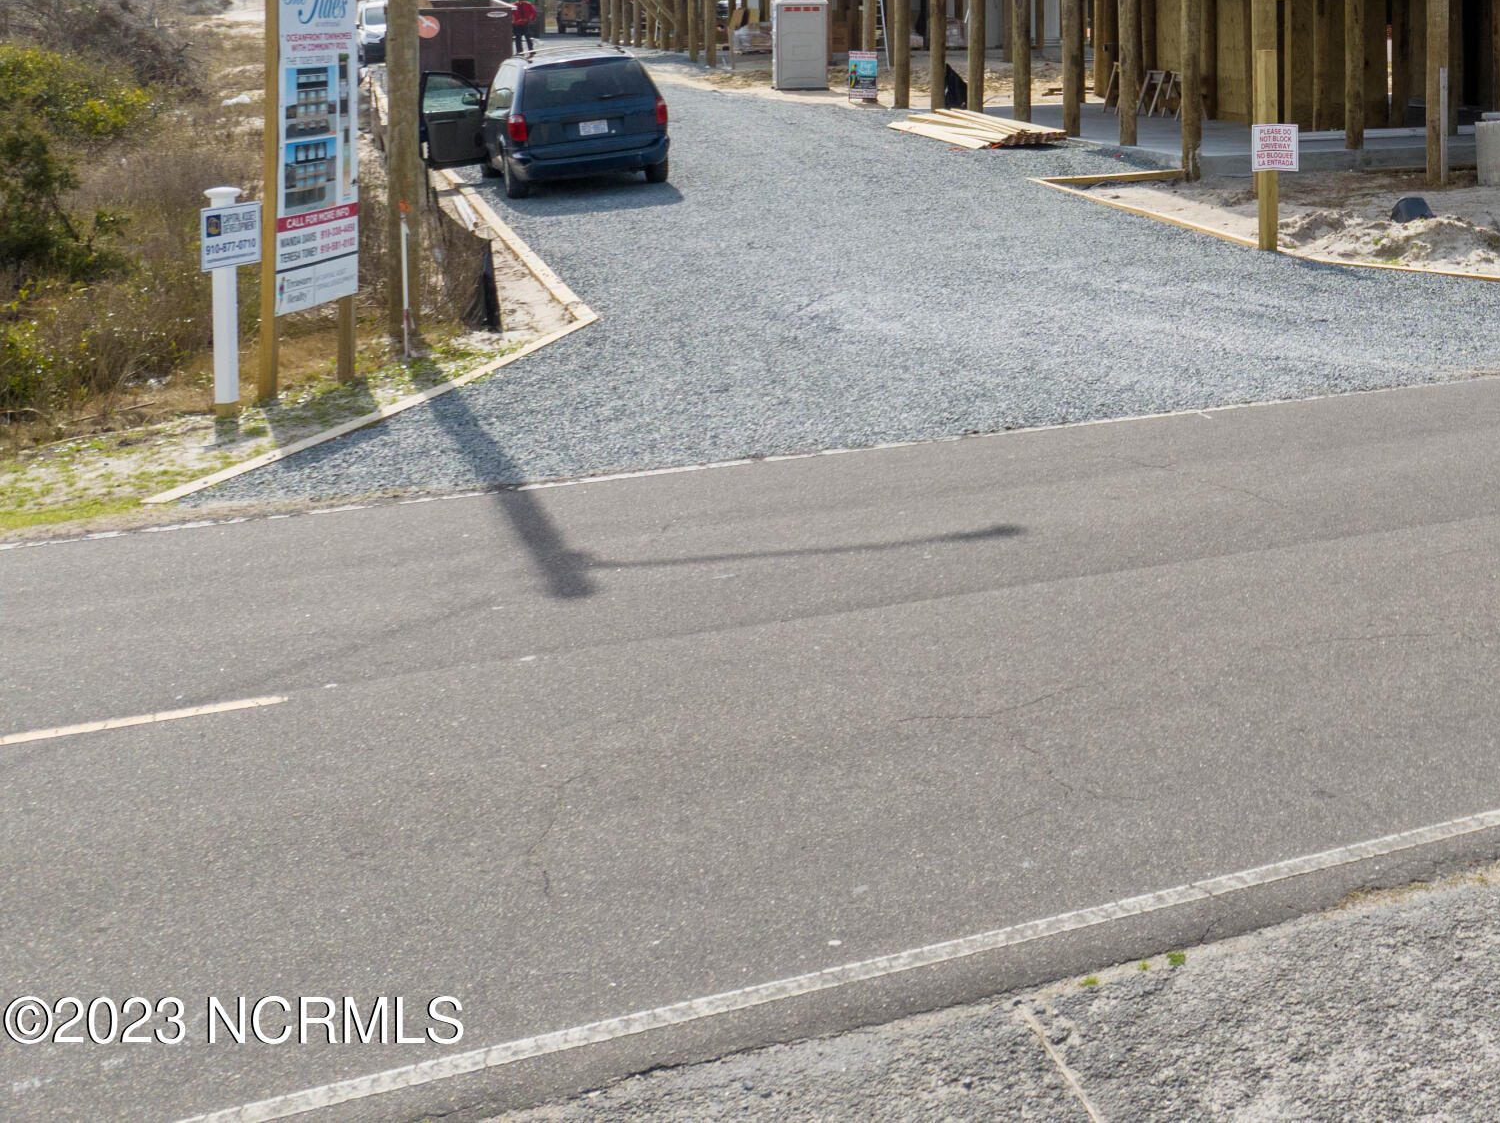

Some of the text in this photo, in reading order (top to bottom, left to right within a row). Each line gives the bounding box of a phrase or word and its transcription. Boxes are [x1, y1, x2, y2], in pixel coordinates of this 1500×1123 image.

[286, 207, 350, 228] CALL FOR MORE INFO
